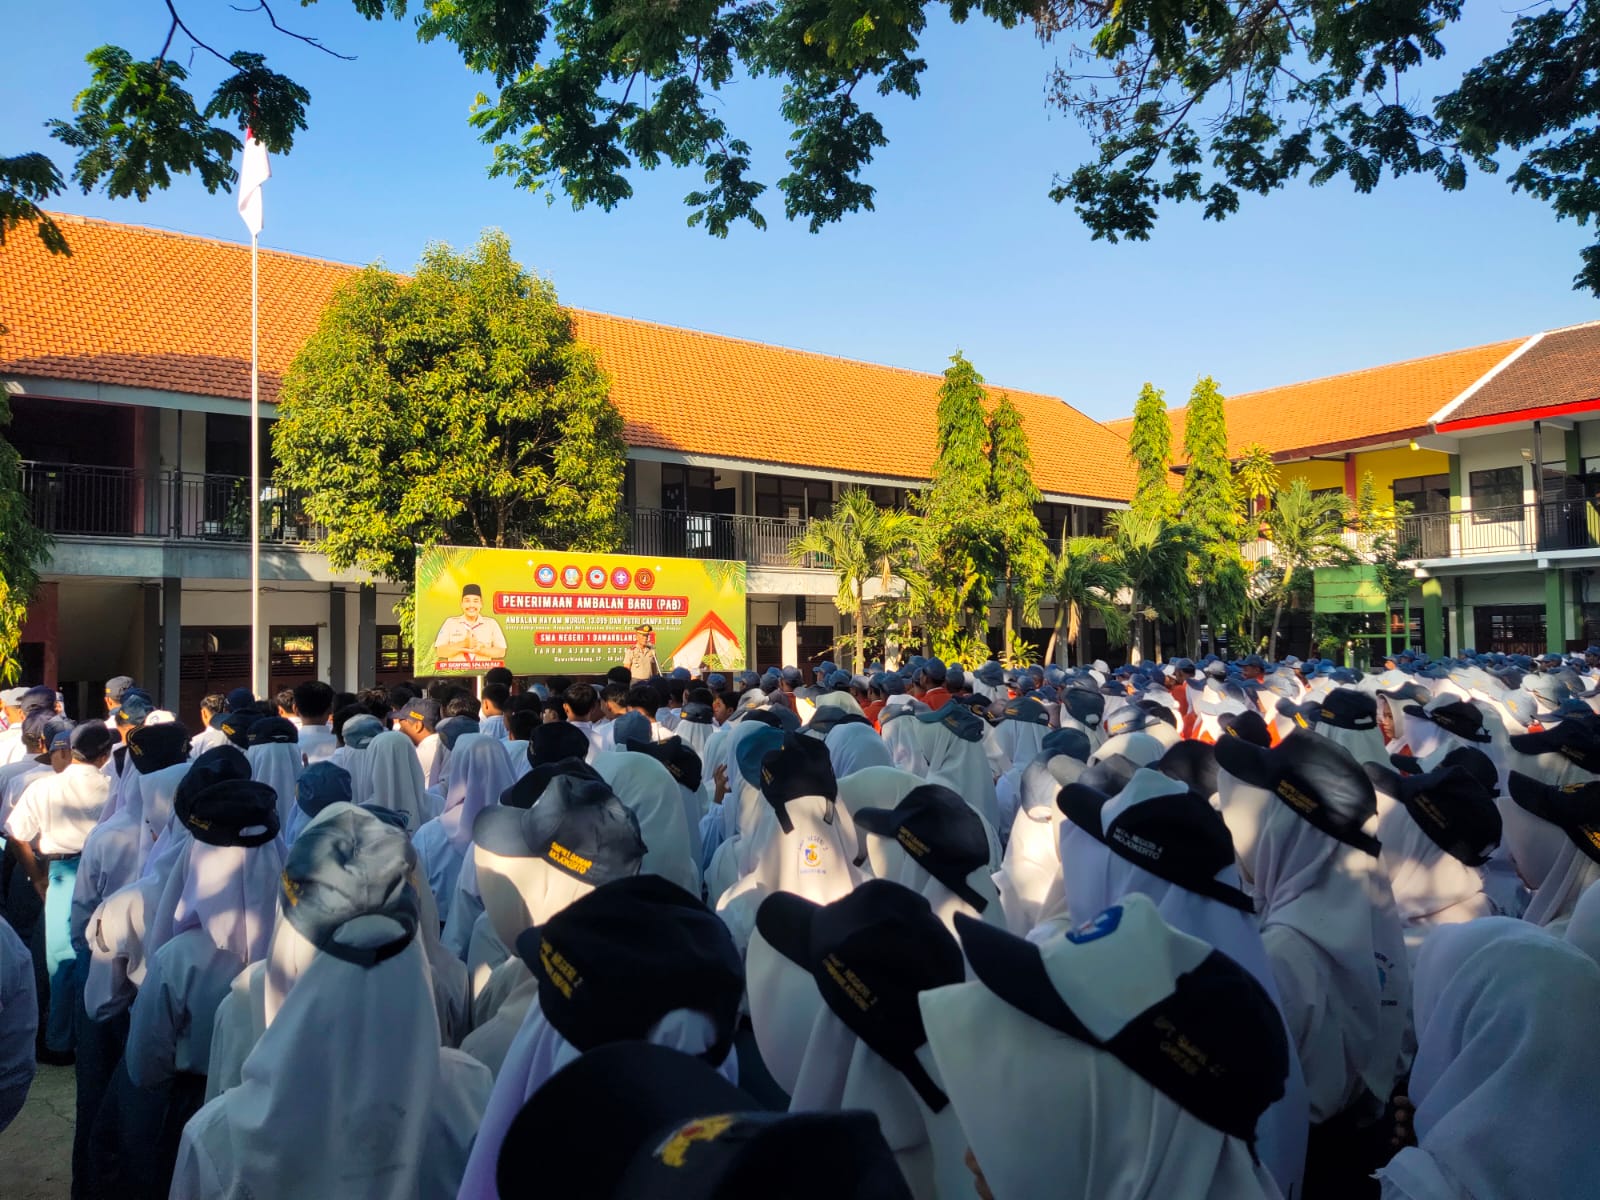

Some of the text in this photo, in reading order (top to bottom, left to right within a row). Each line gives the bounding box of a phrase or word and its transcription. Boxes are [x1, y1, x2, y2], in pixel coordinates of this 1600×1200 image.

[502, 595, 682, 611] PENERIMAAN AMBALAN BARU (PAB)
[506, 616, 538, 624] AMBALAN
